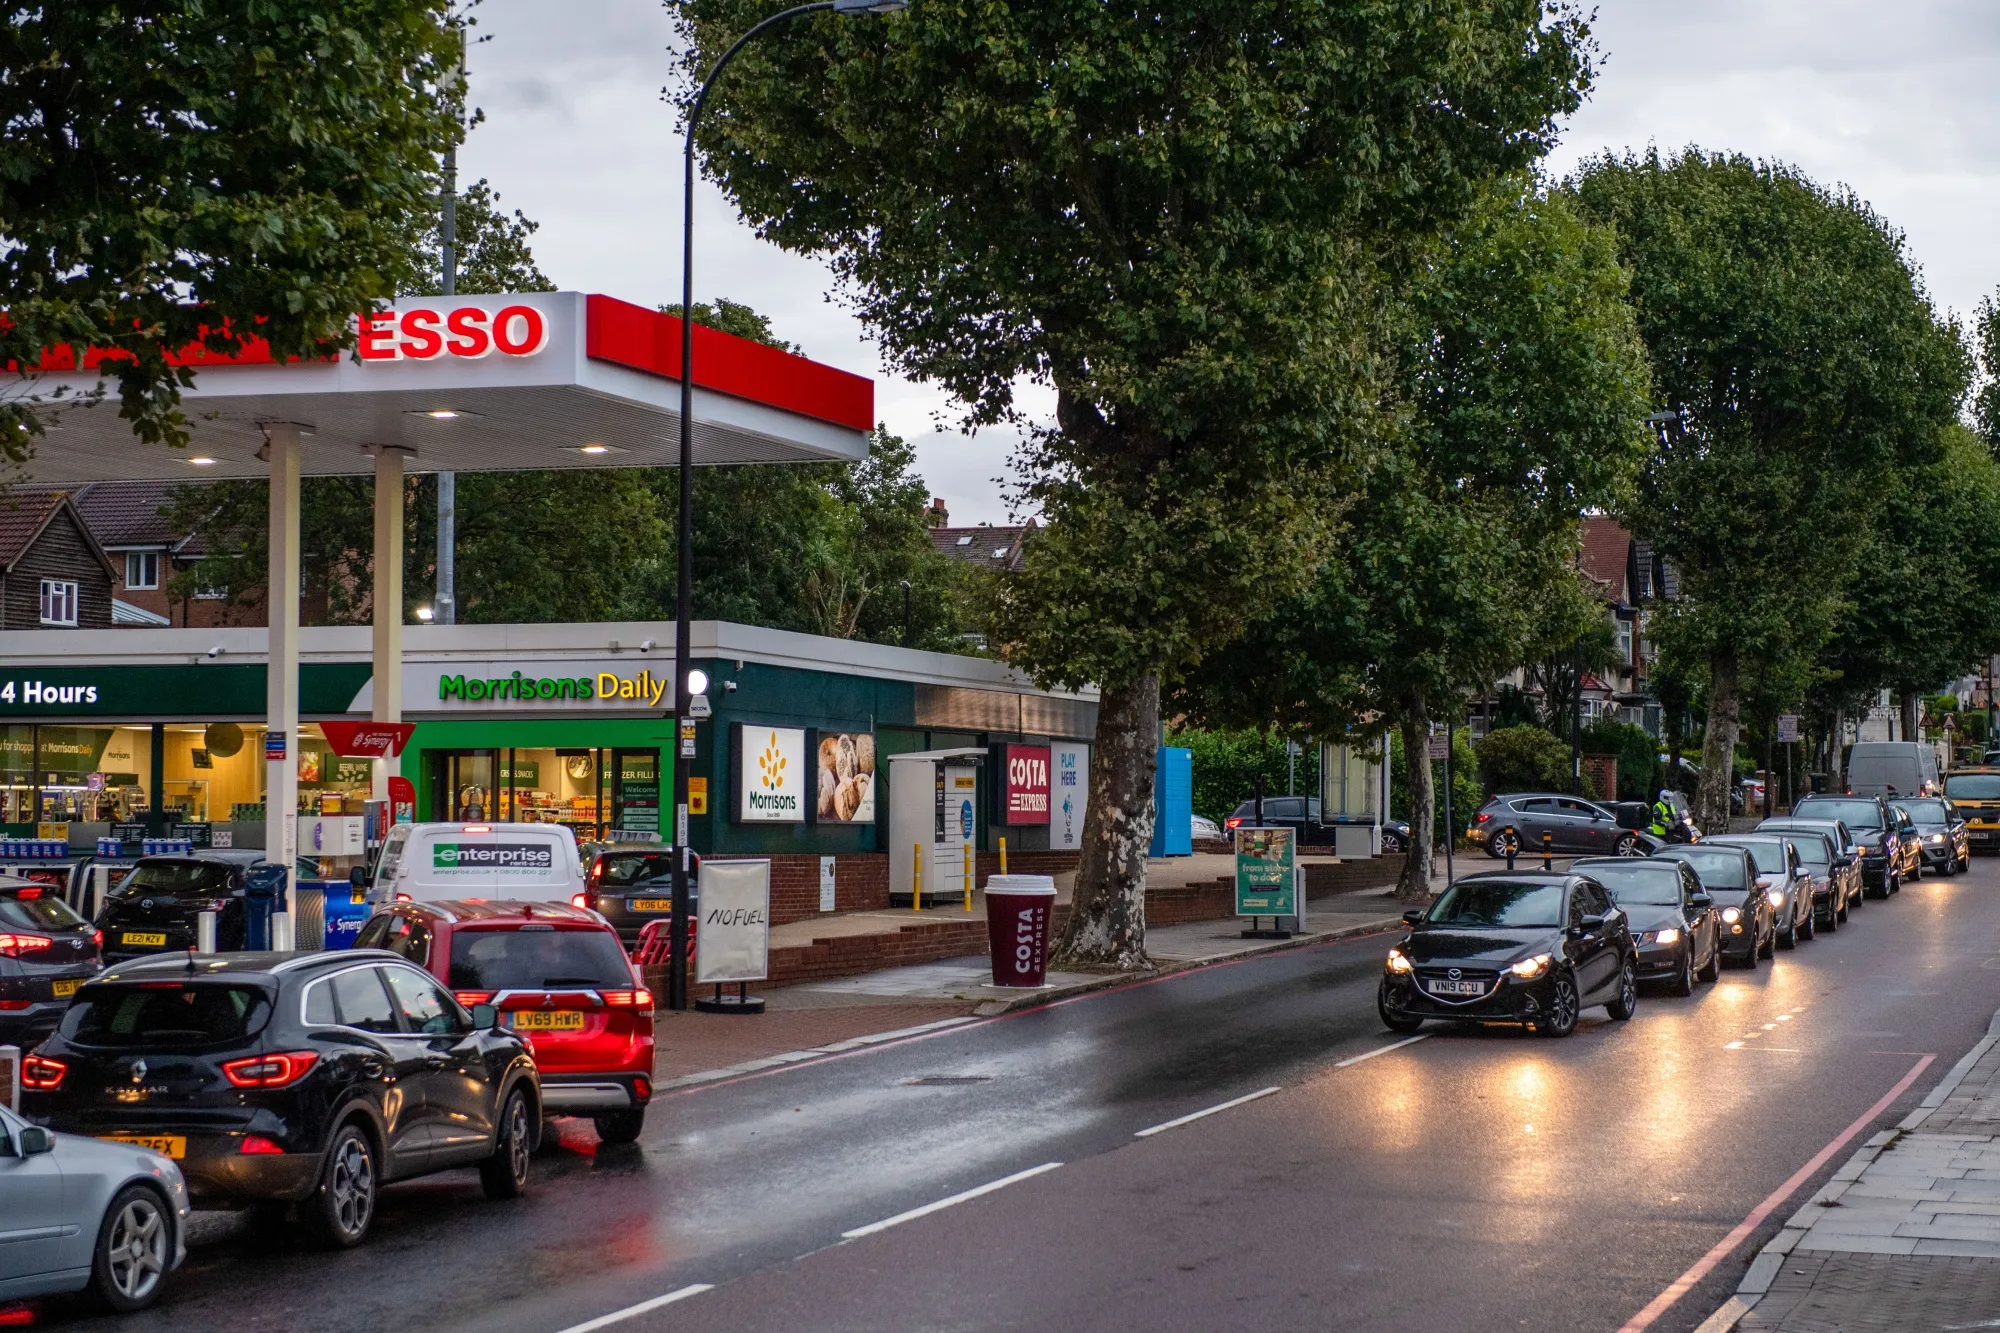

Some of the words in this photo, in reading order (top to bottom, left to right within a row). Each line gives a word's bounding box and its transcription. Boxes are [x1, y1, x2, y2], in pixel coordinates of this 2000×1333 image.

[358, 305, 547, 361] ESSO
[23, 680, 98, 703] Hours
[439, 670, 594, 701] Morrisons
[597, 669, 668, 707] Daily
[362, 734, 391, 748] Synergy
[396, 731, 401, 742] 1
[3, 739, 13, 751] for
[41, 743, 48, 752] at
[48, 741, 79, 753] Morrisons
[79, 743, 93, 757] Daily
[108, 751, 131, 759] Morrisons
[1061, 753, 1076, 768] PLAY
[518, 770, 534, 778] SNACKS
[1010, 758, 1047, 790] COSTA
[1061, 771, 1076, 786] HERE
[749, 790, 796, 810] Morrisons
[1021, 794, 1047, 812] EXPRESS
[440, 848, 551, 864] enterprise
[1242, 864, 1264, 872] from
[634, 902, 656, 910] LY06
[707, 909, 733, 926] NO
[733, 908, 764, 926] FUEL
[337, 918, 362, 934] Synerg
[1016, 908, 1034, 974] COSTA
[1034, 908, 1044, 963] EXPRESS
[1435, 982, 1456, 992] VN19
[516, 1012, 552, 1026] LV69
[555, 1012, 580, 1025] HWR
